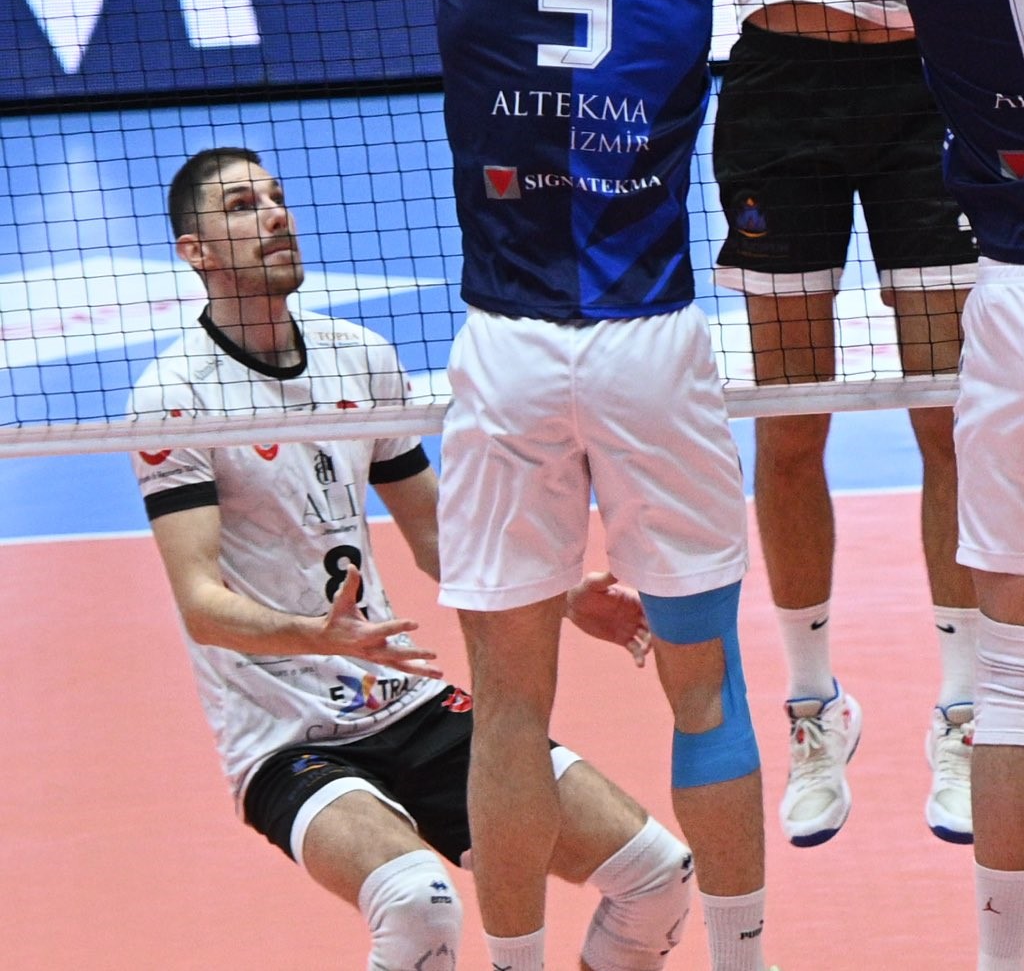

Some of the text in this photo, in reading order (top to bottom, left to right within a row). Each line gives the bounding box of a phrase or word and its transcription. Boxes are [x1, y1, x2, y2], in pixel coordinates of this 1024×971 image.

[491, 90, 649, 125] ALTEKMA
[524, 173, 663, 195] SIGNATEKMA
[323, 544, 364, 605] 8
